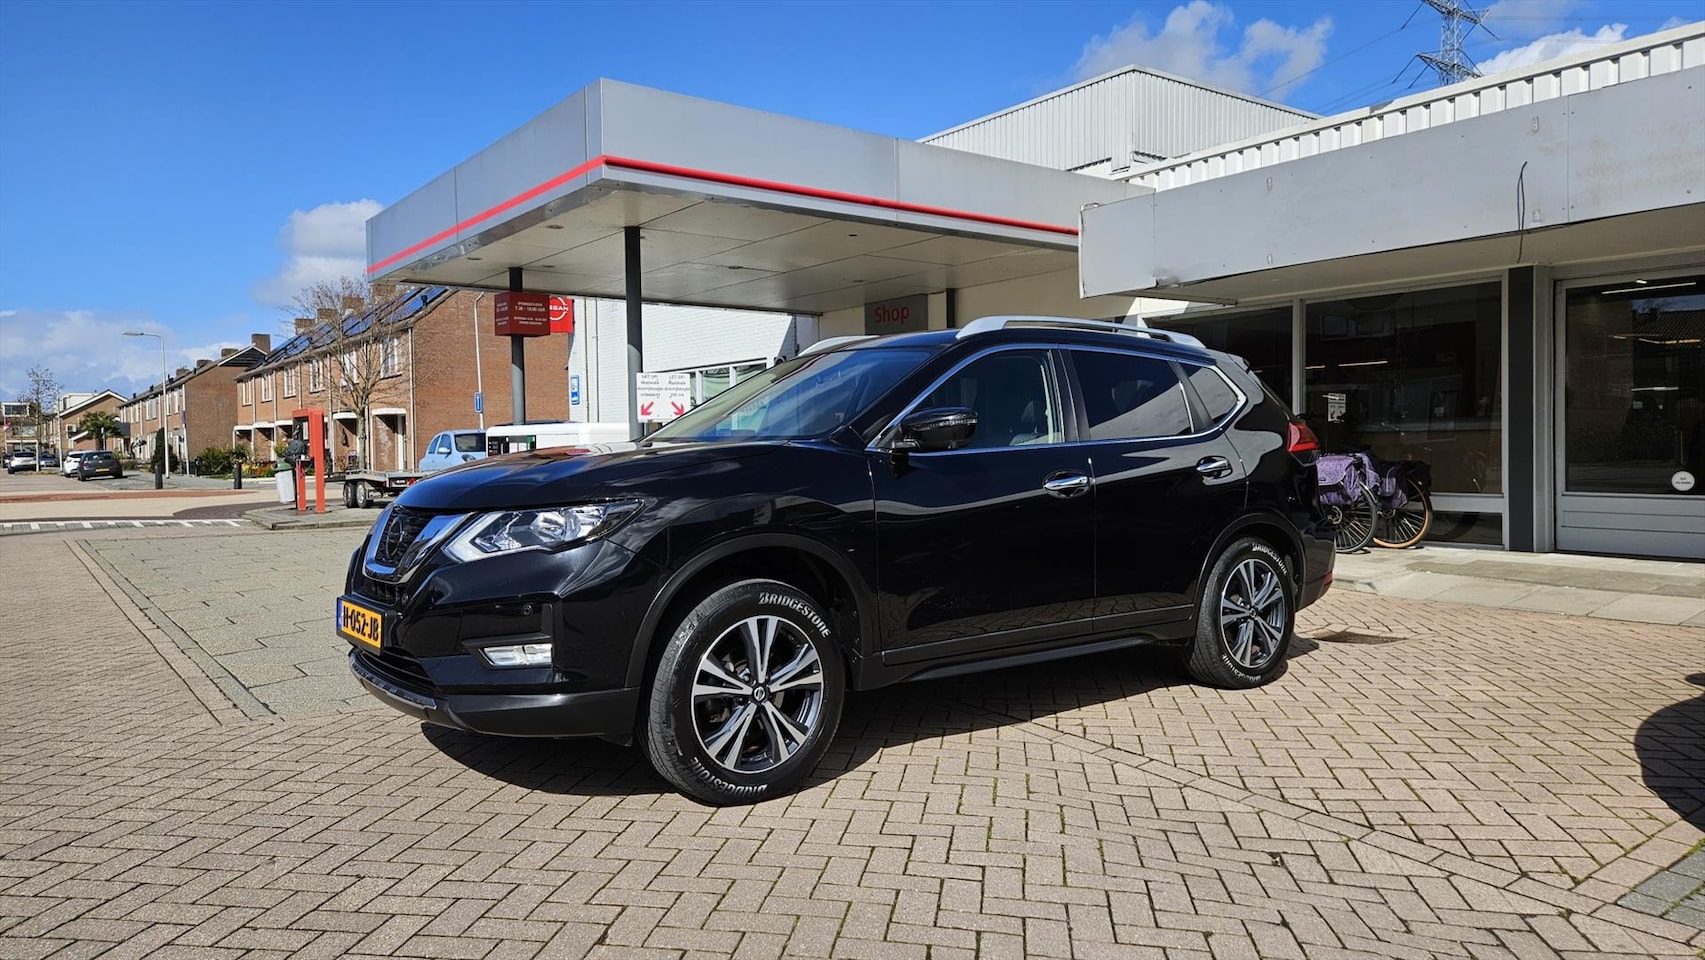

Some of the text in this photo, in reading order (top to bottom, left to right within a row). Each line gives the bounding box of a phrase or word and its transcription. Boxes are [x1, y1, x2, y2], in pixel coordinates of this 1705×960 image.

[874, 304, 910, 325] Shop
[343, 605, 379, 642] H-052-JB
[758, 591, 832, 638] BRIDGESTONE
